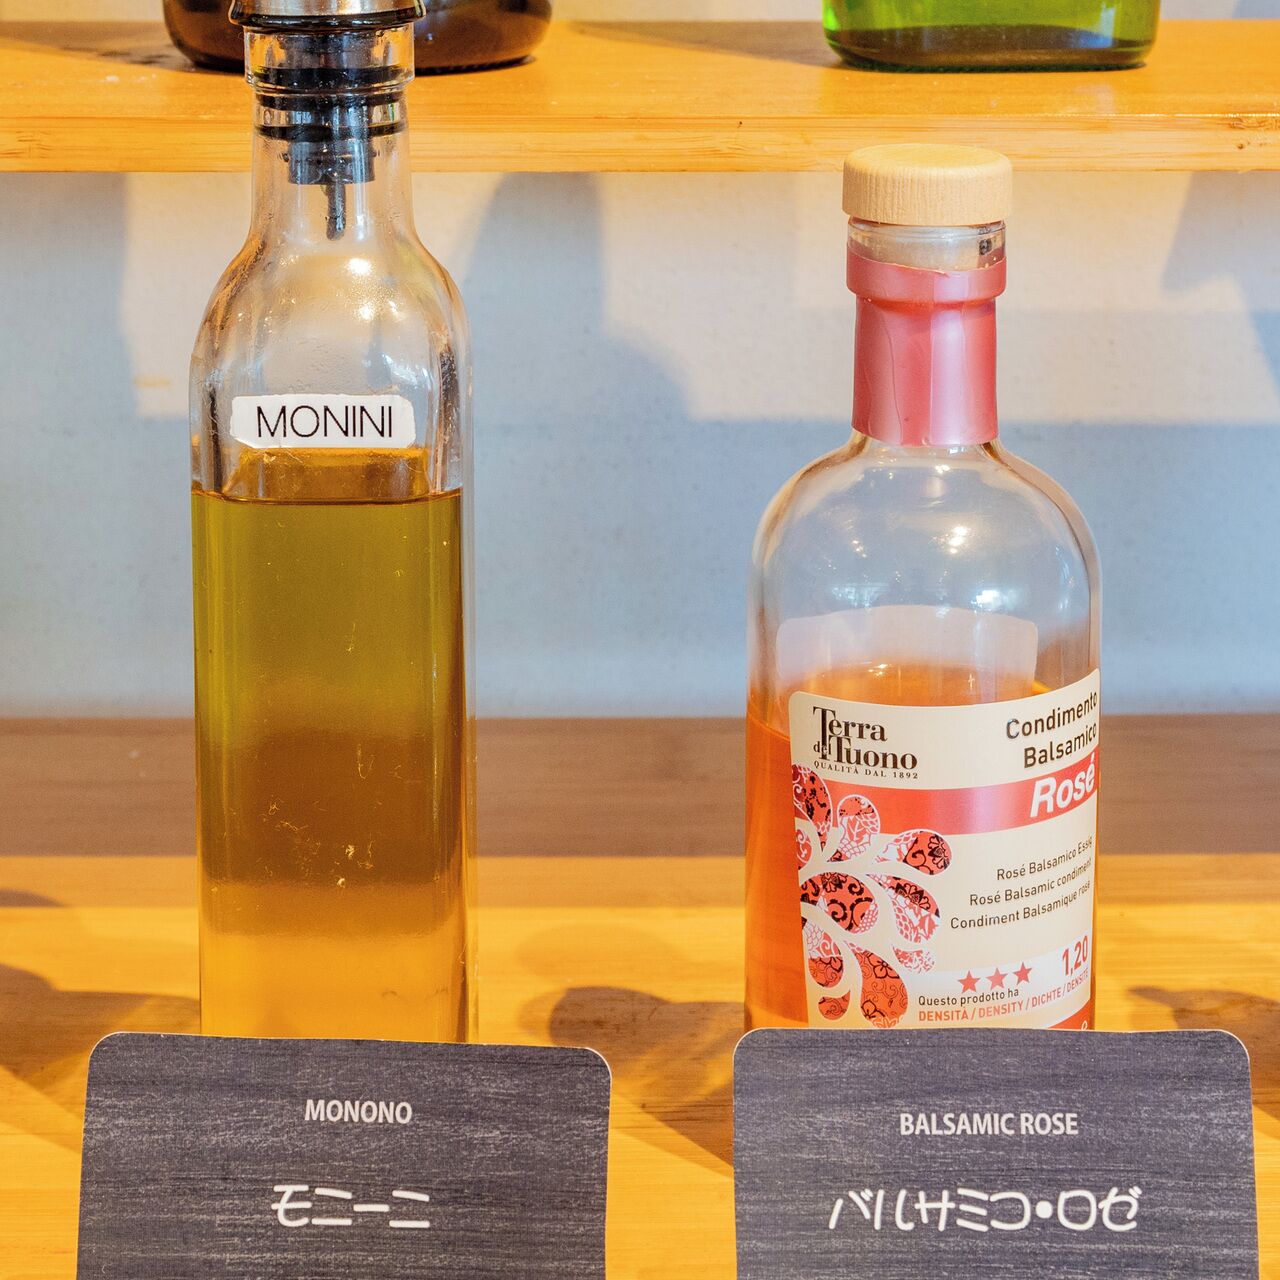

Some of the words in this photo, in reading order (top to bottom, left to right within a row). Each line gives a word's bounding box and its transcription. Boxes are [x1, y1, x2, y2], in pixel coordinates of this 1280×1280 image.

[257, 405, 392, 437] MONINI
[813, 706, 888, 759] Terra
[1006, 691, 1097, 739] Condimento
[1024, 722, 1097, 768] Balsamico
[865, 769, 886, 778] DAL
[893, 770, 919, 780] 1892
[1030, 753, 1096, 818] Rosé
[969, 890, 1001, 907] Rosé
[1004, 879, 1055, 904] Balsamic
[1056, 857, 1092, 887] condiment
[997, 863, 1026, 881] Rosé
[1029, 849, 1077, 874] Balsamico
[950, 909, 1020, 930] Condiment
[1023, 892, 1078, 919] Balsamique
[1062, 935, 1089, 977] 1,20
[919, 995, 957, 1006] Questo
[960, 992, 1005, 1007] prodotto
[1008, 988, 1019, 998] ha
[919, 1007, 969, 1021] DENSITÀ
[978, 1000, 1023, 1018] DENSITY
[1032, 987, 1062, 1007] DICHTE
[304, 1099, 413, 1124] MONONO
[900, 1113, 1015, 1136] BALSAMIC
[1020, 1113, 1079, 1136] ROSE
[271, 1184, 431, 1228] モニーニ
